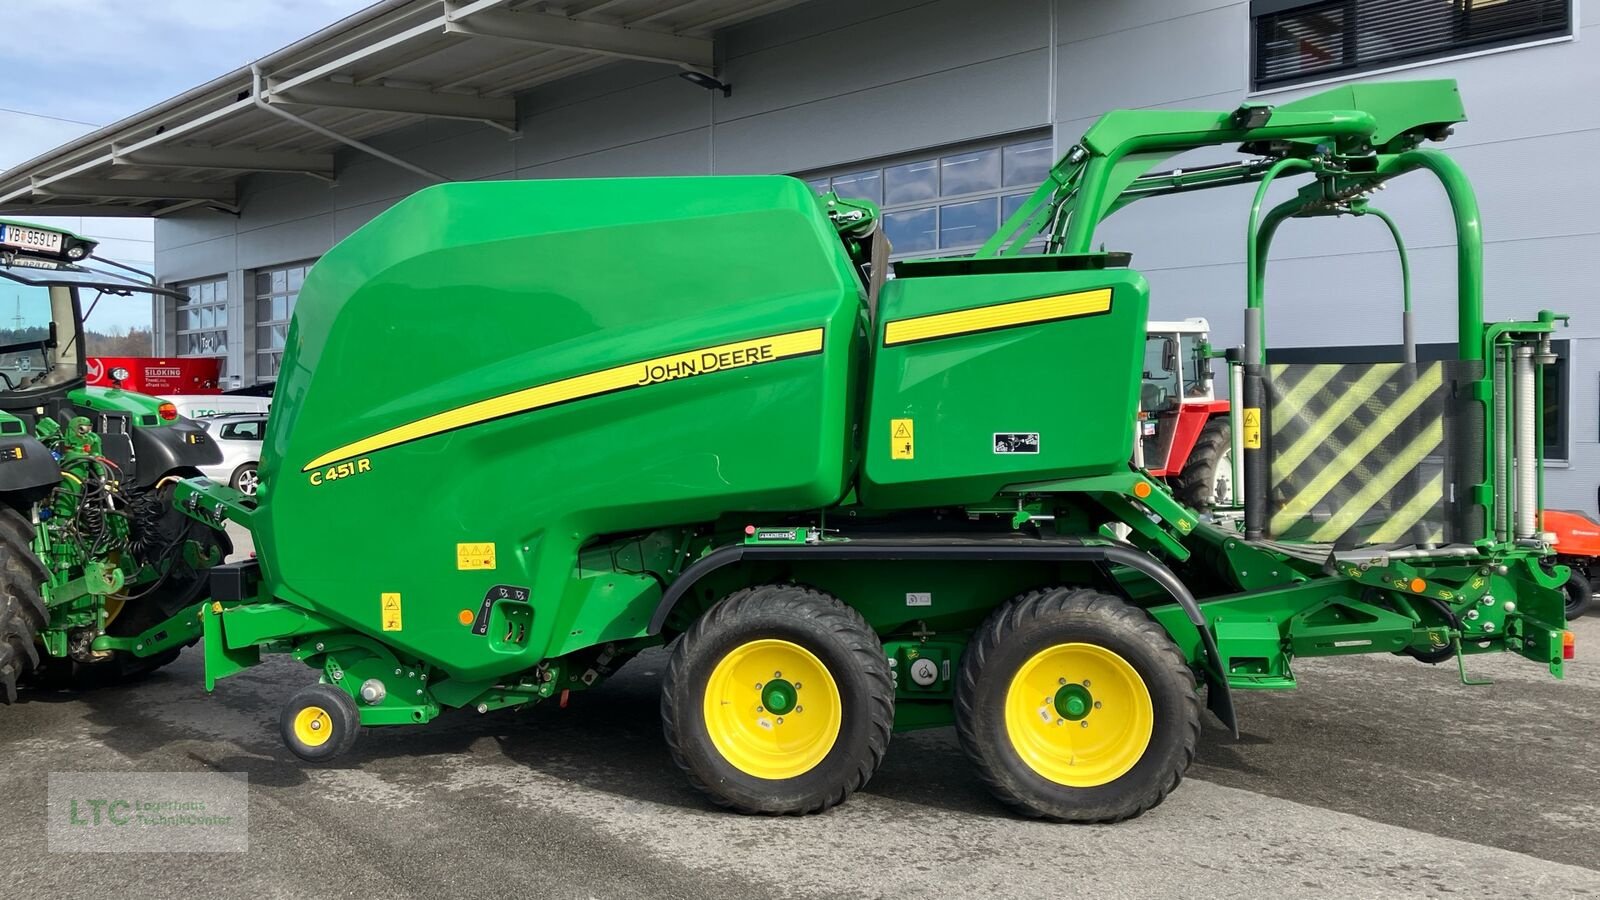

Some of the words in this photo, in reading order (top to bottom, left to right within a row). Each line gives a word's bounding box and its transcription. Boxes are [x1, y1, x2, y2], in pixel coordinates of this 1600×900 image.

[9, 227, 20, 242] VB
[638, 359, 696, 383] JOHN
[701, 344, 774, 371] DEERE
[310, 471, 322, 486] C
[325, 461, 355, 481] 451
[357, 458, 371, 473] R
